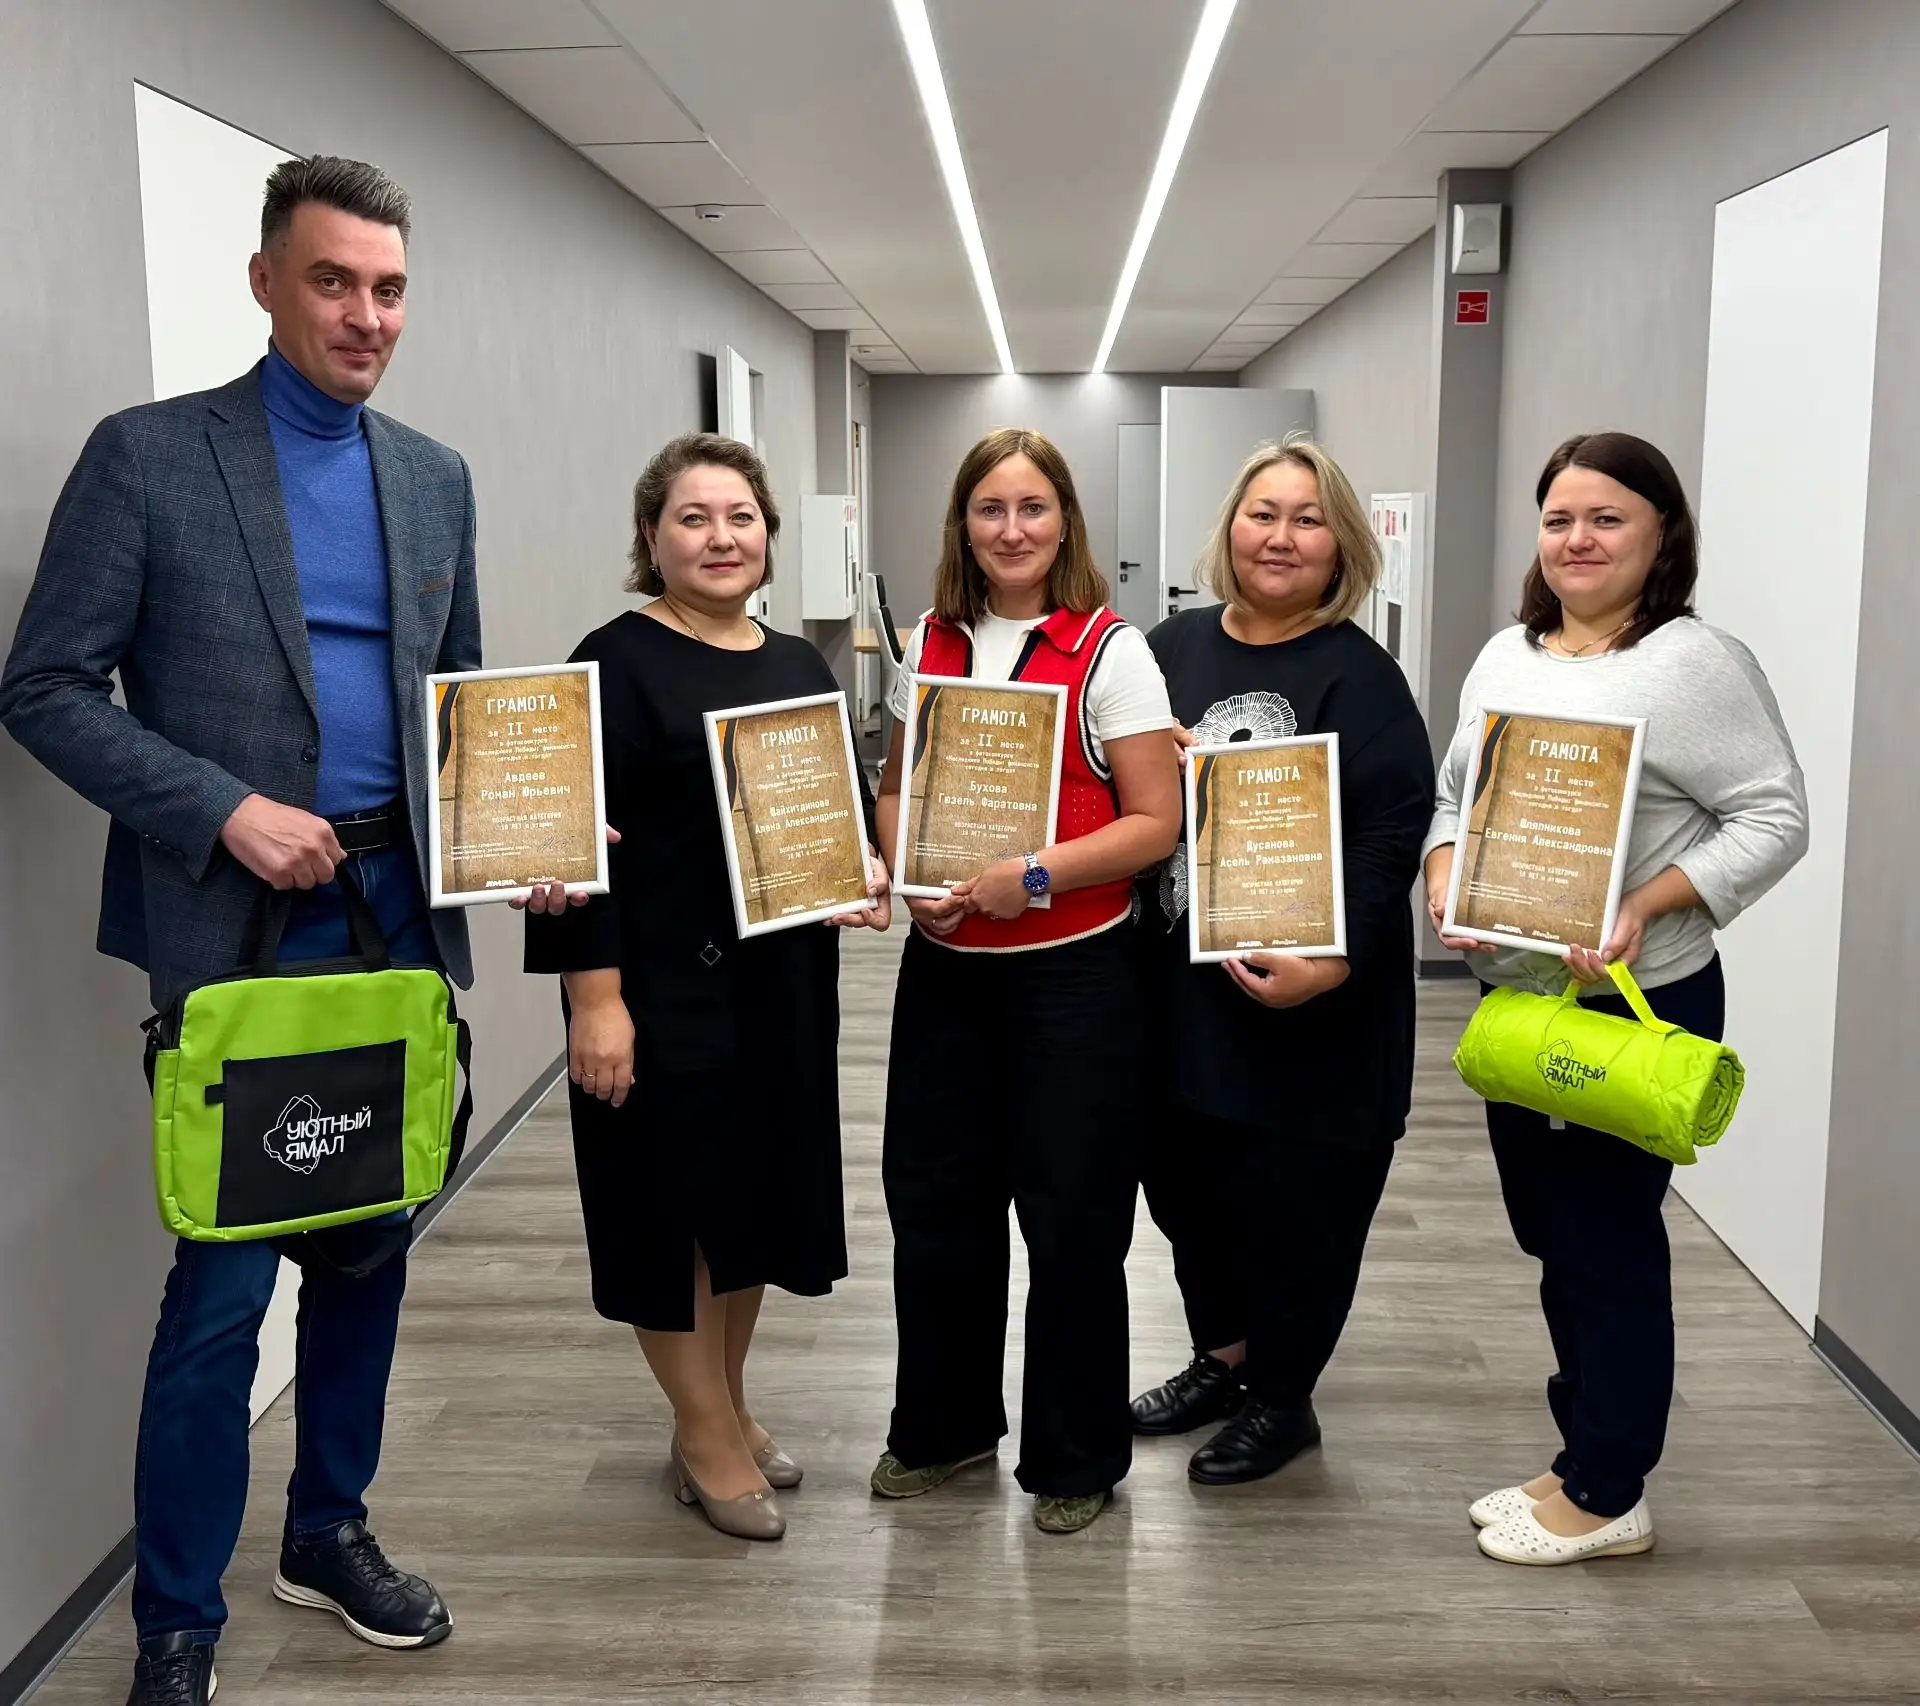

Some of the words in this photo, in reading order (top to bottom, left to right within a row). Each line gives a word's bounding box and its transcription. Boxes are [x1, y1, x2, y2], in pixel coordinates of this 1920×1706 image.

[487, 695, 557, 714] ГРАМОТА
[962, 707, 1027, 727] ГРАМОТА
[508, 722, 525, 736] II
[532, 726, 558, 734] место
[761, 725, 818, 749] ГРАМОТА
[978, 734, 994, 747] II
[1530, 739, 1598, 763] ГРАМОТА
[781, 753, 794, 768] II
[801, 755, 821, 764] место
[504, 772, 546, 783] Авдеев
[1238, 766, 1300, 785] ГРАМОТА
[1544, 768, 1561, 784] II
[1568, 778, 1594, 787] место
[481, 789, 515, 800] Роман
[522, 785, 570, 797] Юрьевич
[970, 781, 1007, 794] Бухова
[770, 799, 829, 817] Шайхитдинова
[938, 793, 974, 806] Гюзель
[981, 797, 1037, 811] Фаратовна
[1256, 792, 1271, 806] II
[755, 823, 780, 834] Алена
[785, 809, 848, 827] Александровна
[1519, 818, 1581, 836] Шляпникова
[1247, 840, 1295, 853] Дусанова
[1485, 828, 1526, 843] Евгения
[1532, 836, 1613, 857] Александровна
[1220, 857, 1250, 868] Асель
[1256, 852, 1322, 865] Рамазановна
[1548, 1053, 1606, 1082] УЮТНЫЙ
[1545, 1067, 1585, 1090] ЯМАЛ
[287, 1105, 372, 1140] УЮТНЫЙ
[285, 1135, 344, 1161] ЯМАЛ
